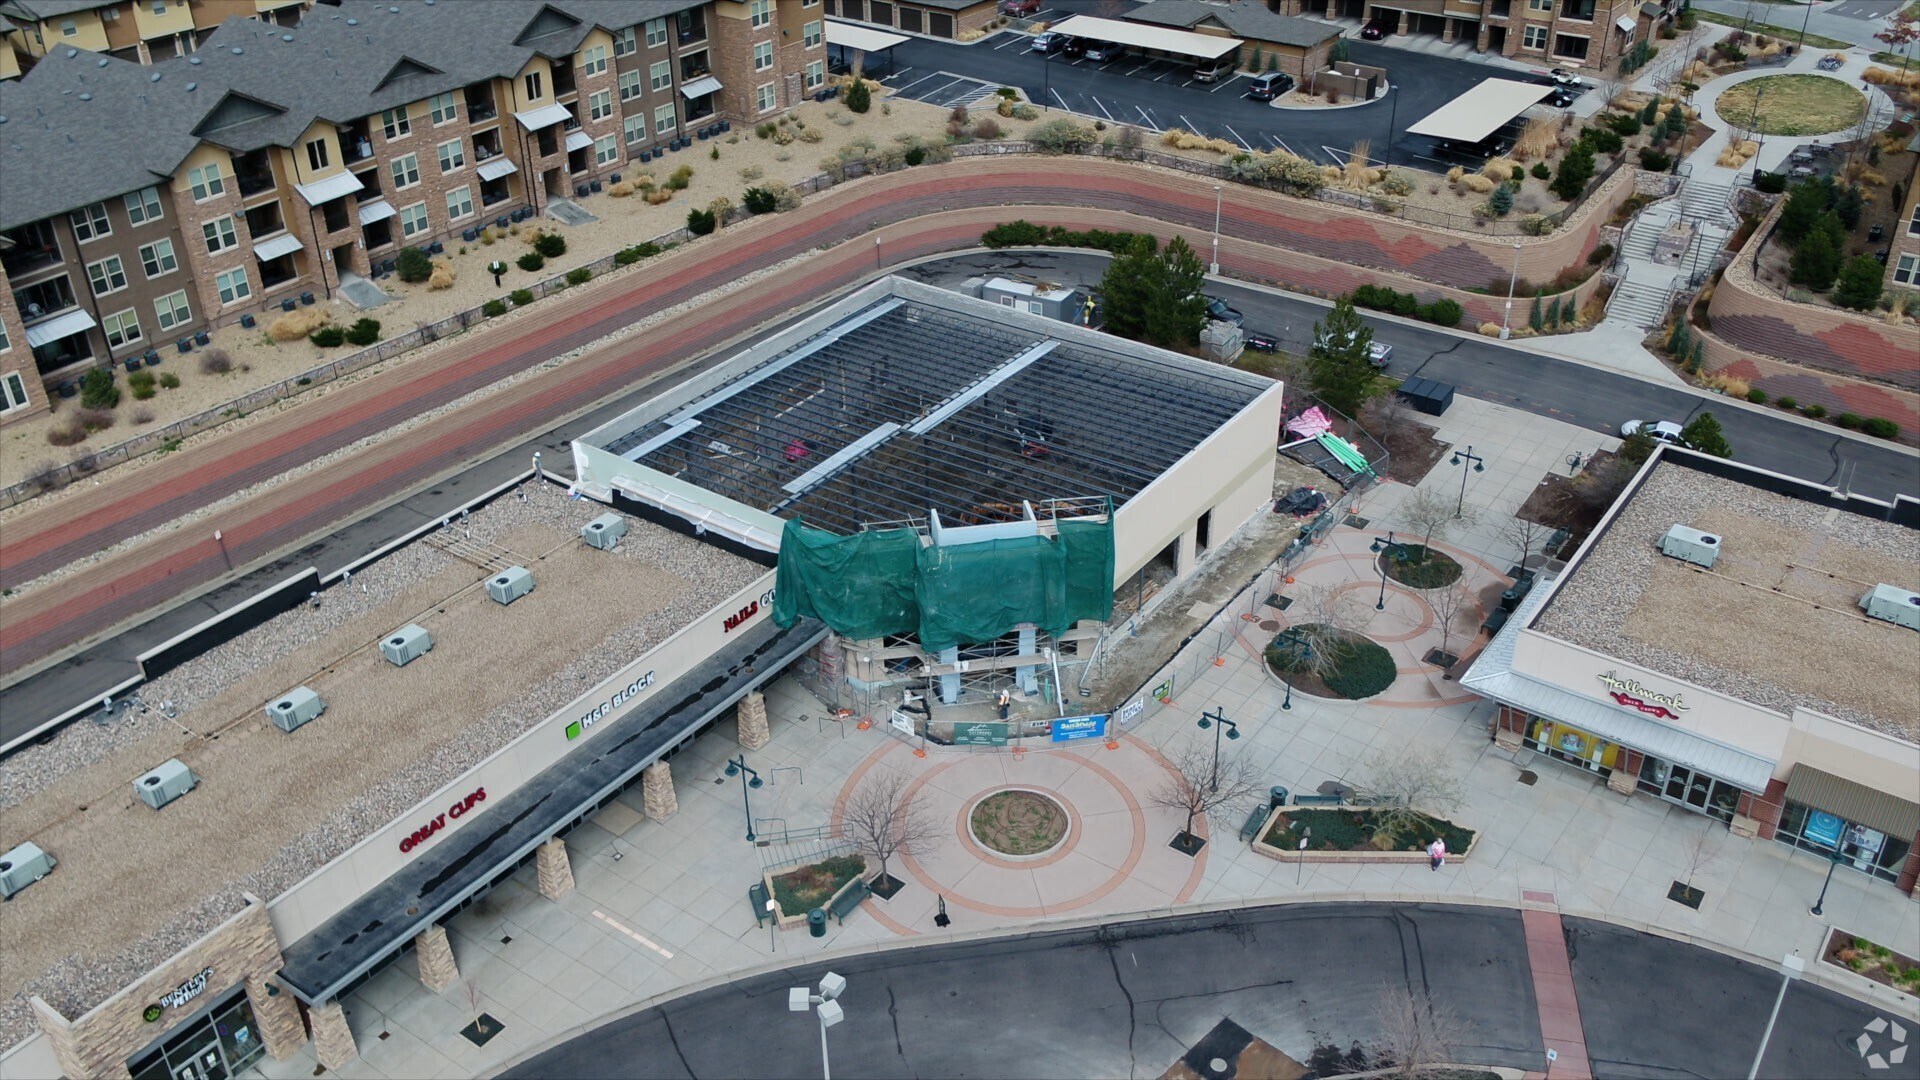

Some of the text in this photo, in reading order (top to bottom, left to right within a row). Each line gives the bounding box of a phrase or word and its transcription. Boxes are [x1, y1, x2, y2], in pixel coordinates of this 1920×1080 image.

[722, 600, 759, 633] NAILS
[581, 670, 656, 730] H&R BLOCK
[1597, 669, 1691, 712] Hallmark
[399, 787, 487, 853] GREAT CLIPS
